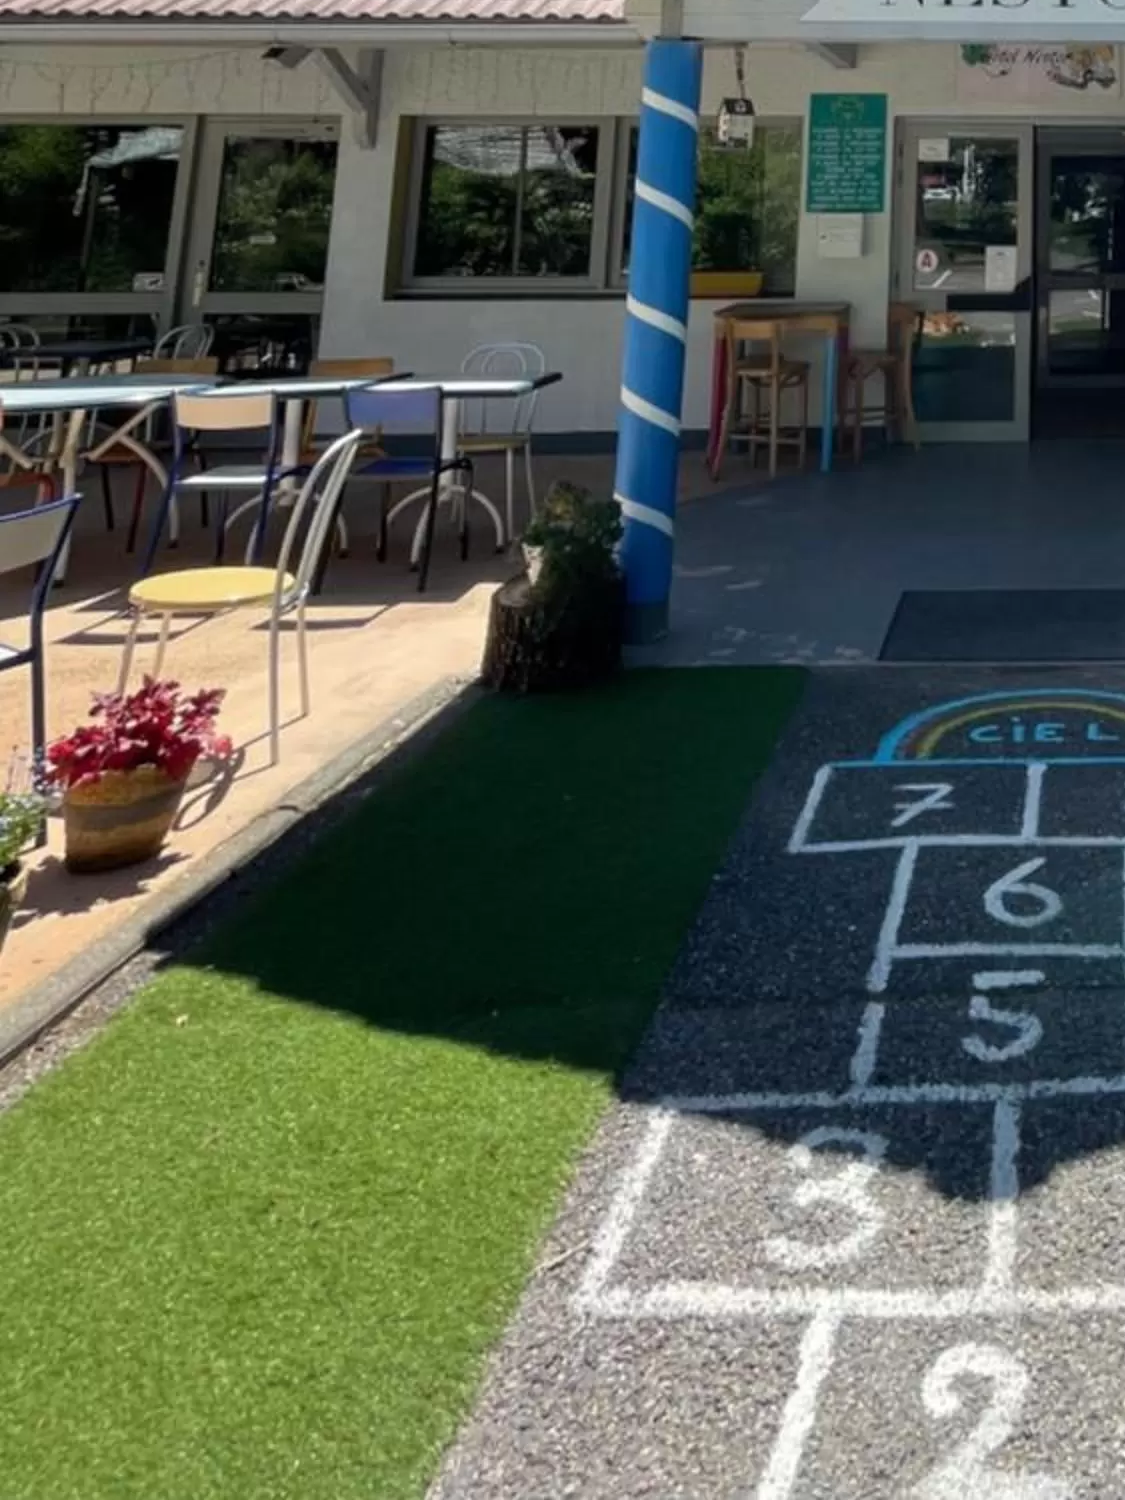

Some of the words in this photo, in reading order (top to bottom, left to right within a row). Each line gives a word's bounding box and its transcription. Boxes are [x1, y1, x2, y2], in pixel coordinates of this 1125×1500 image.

[891, 782, 955, 827] 7
[983, 857, 1063, 927] 6
[961, 969, 1046, 1063] 5
[764, 1124, 891, 1270] 3
[920, 1341, 1078, 1500] 2
